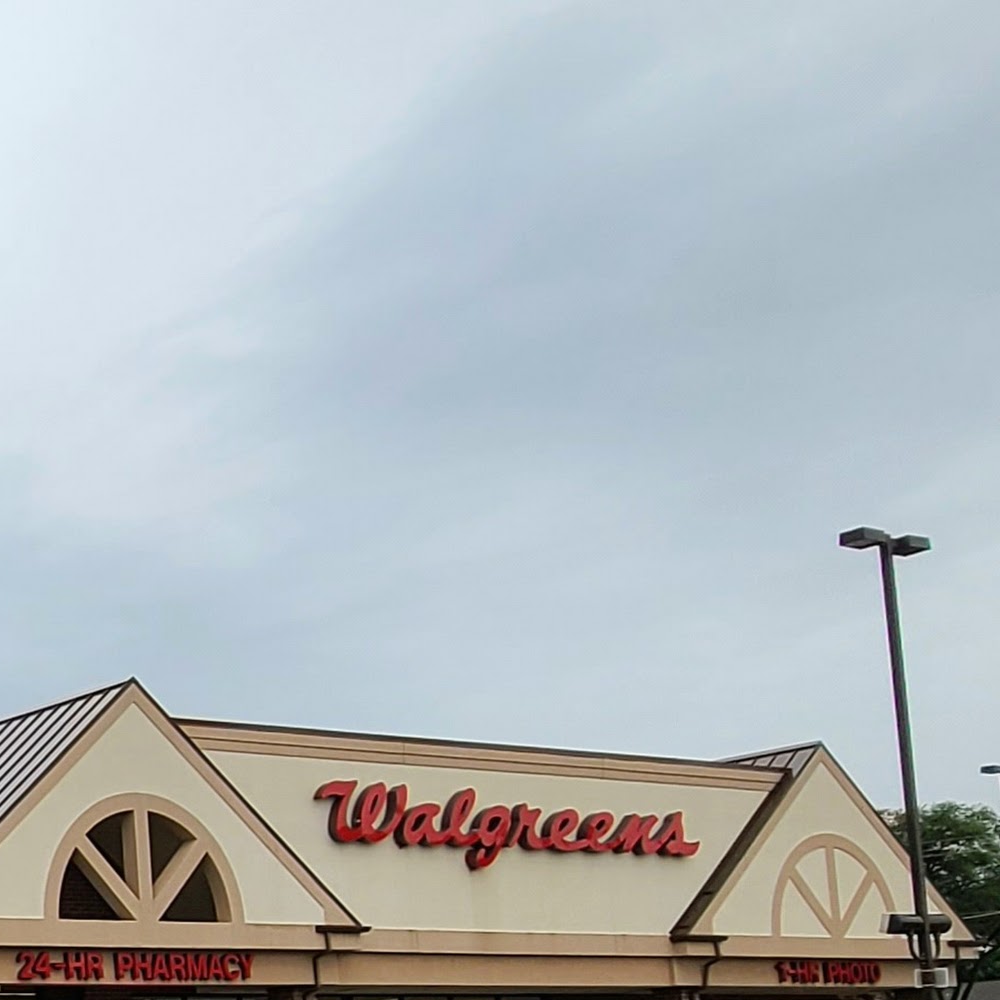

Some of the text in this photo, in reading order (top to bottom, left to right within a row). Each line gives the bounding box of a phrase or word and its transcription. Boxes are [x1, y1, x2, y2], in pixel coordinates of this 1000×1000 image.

[313, 780, 700, 871] Walgreens
[16, 951, 255, 981] 24-HR PHARMACY
[774, 961, 881, 985] 1-HR PHOTO
